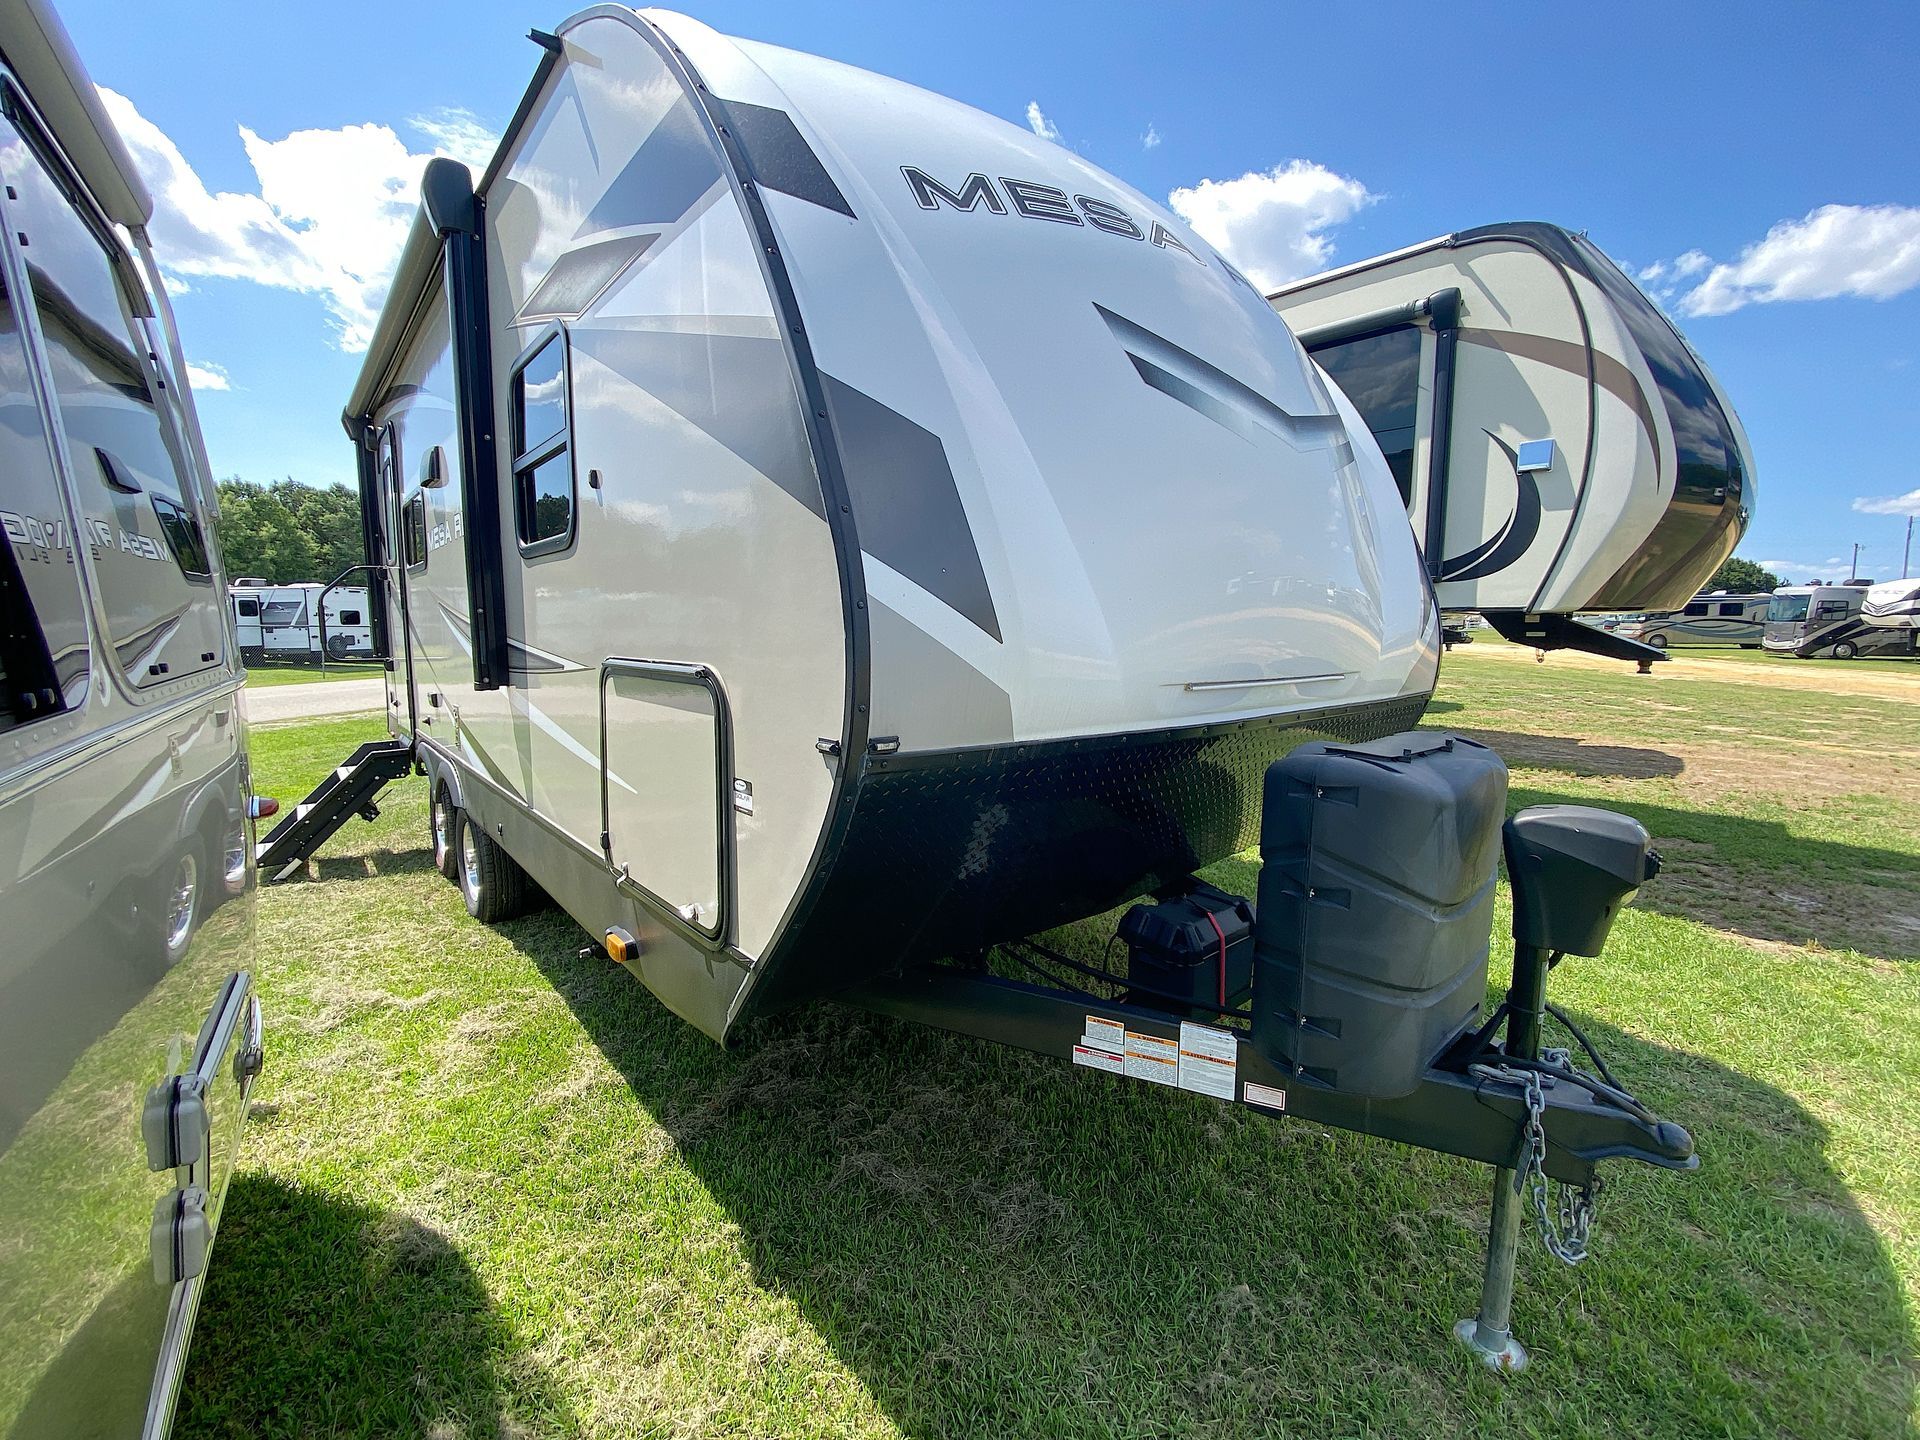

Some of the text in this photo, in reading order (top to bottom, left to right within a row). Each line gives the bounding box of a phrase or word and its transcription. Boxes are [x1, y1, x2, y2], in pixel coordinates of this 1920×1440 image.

[899, 165, 1207, 267] MESA
[1142, 1036, 1165, 1044] WARNING
[1141, 1054, 1164, 1063] WARNING
